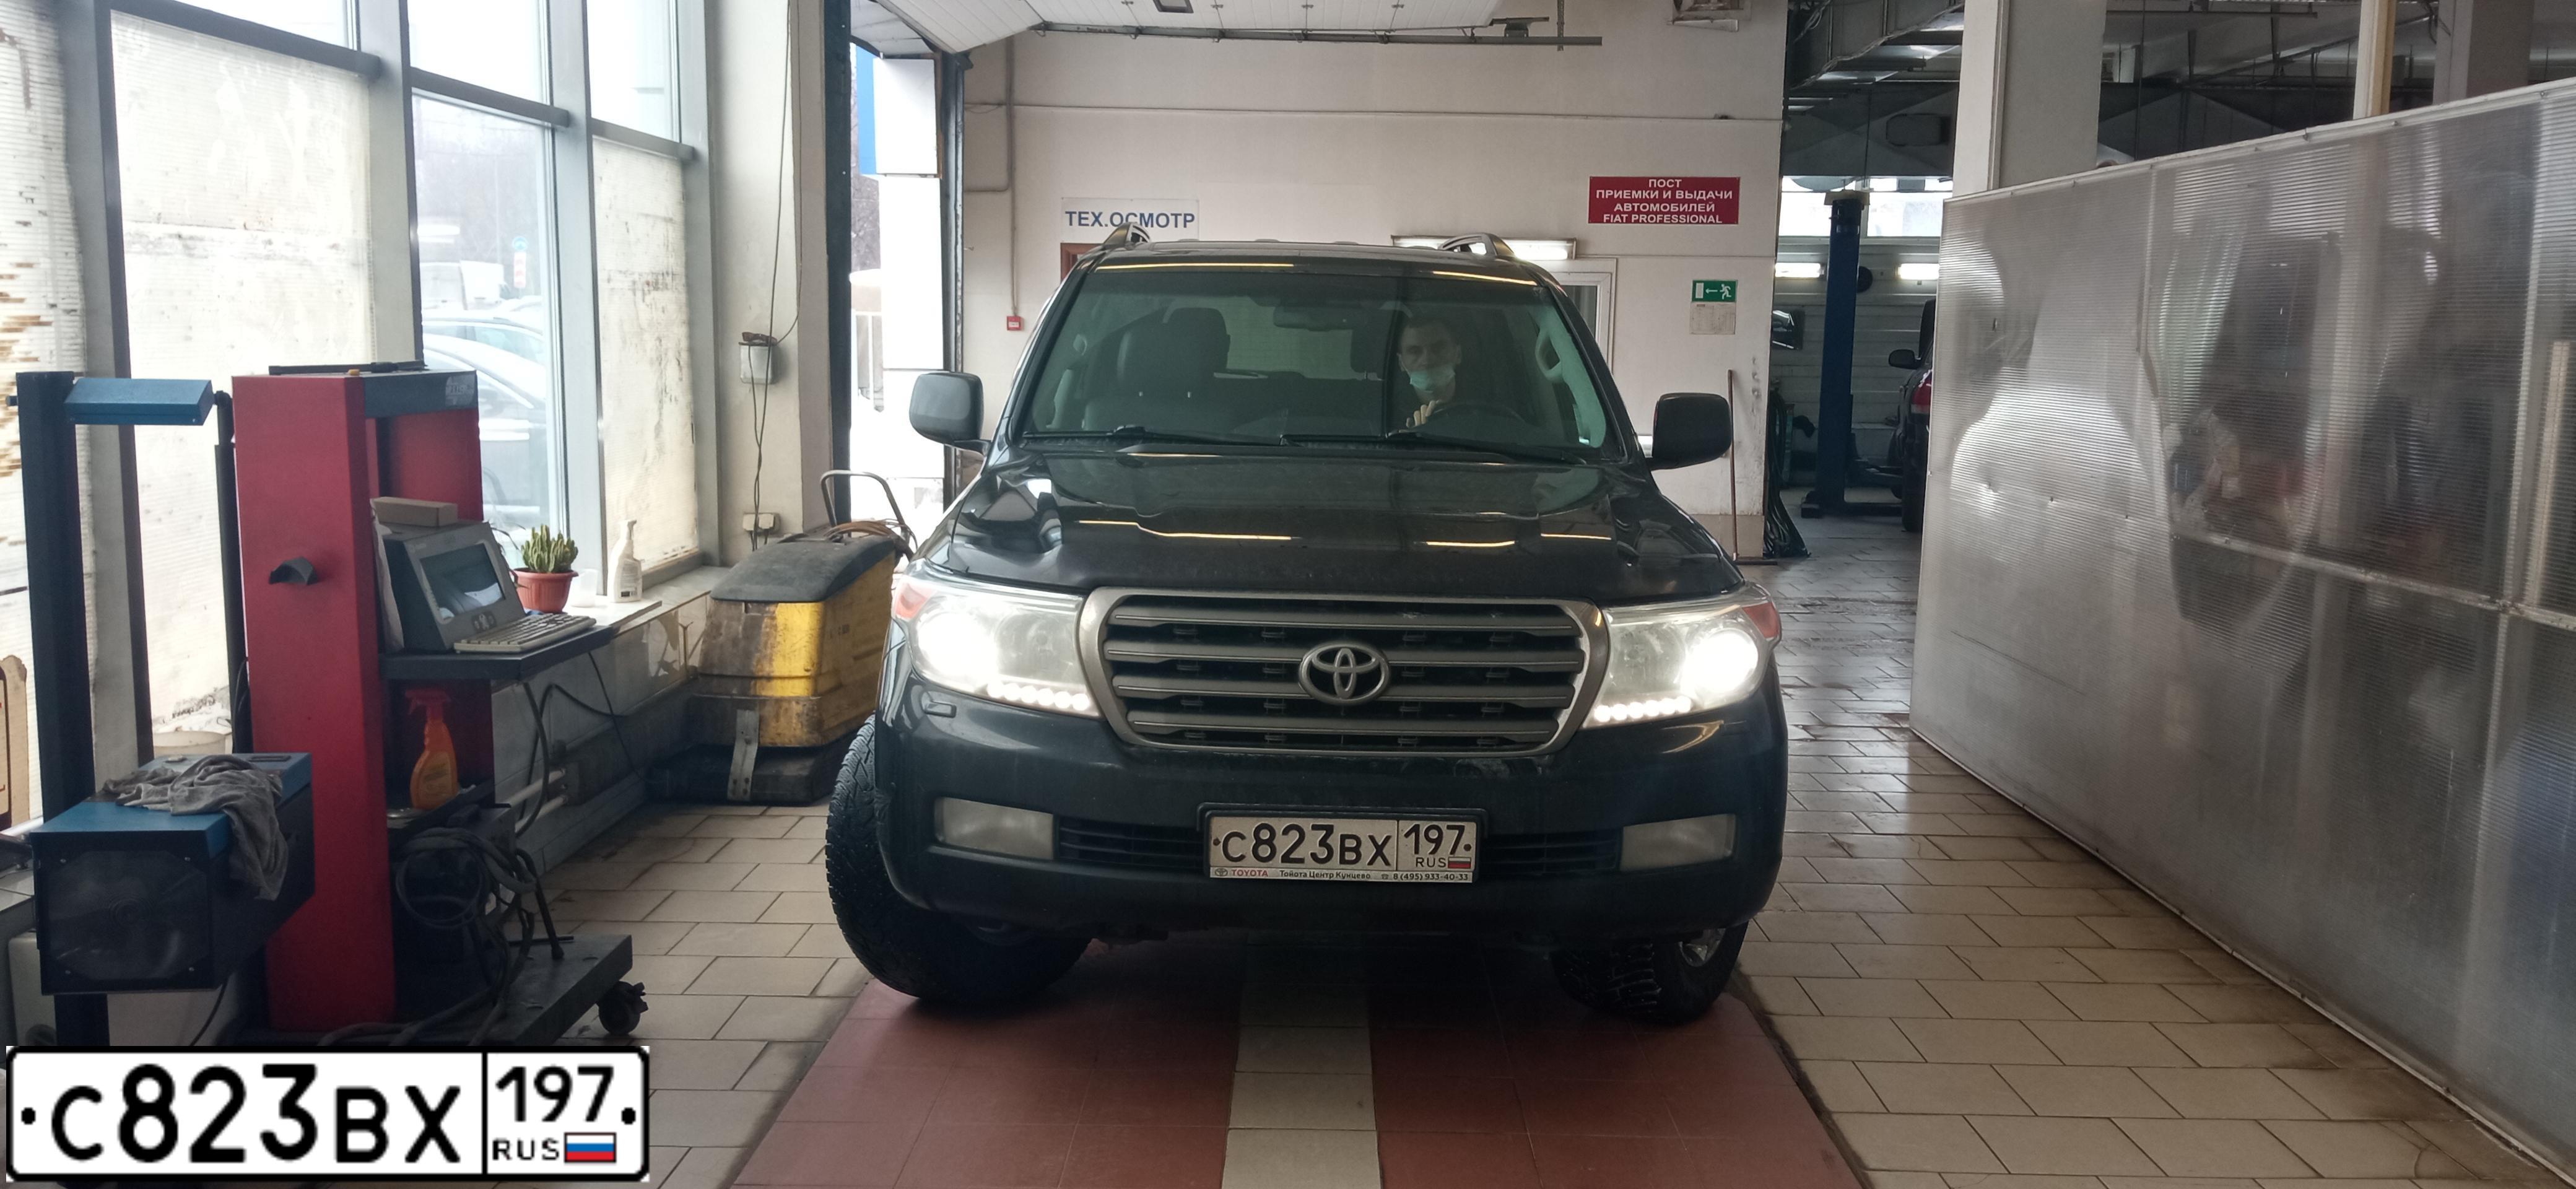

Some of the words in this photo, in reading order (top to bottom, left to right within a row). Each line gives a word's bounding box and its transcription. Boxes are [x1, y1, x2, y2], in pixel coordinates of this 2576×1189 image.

[1648, 179, 1682, 188] ПОСТ
[1596, 190, 1659, 199] ПРИЕМКИ
[1663, 190, 1671, 199] И
[1676, 190, 1733, 201] ВЫДАЧИ
[1614, 202, 1715, 212] АВТОМОБИЛЕЙ
[1603, 214, 1628, 223] FIAT
[1632, 214, 1723, 224] PROFESSIONAL
[1403, 824, 1466, 856] 197
[1416, 856, 1447, 868] RUS
[1231, 869, 1268, 878] TOYOTA
[1279, 869, 1307, 878] Тойота
[1309, 871, 1333, 879] Центр
[1336, 871, 1371, 879] Кунцево
